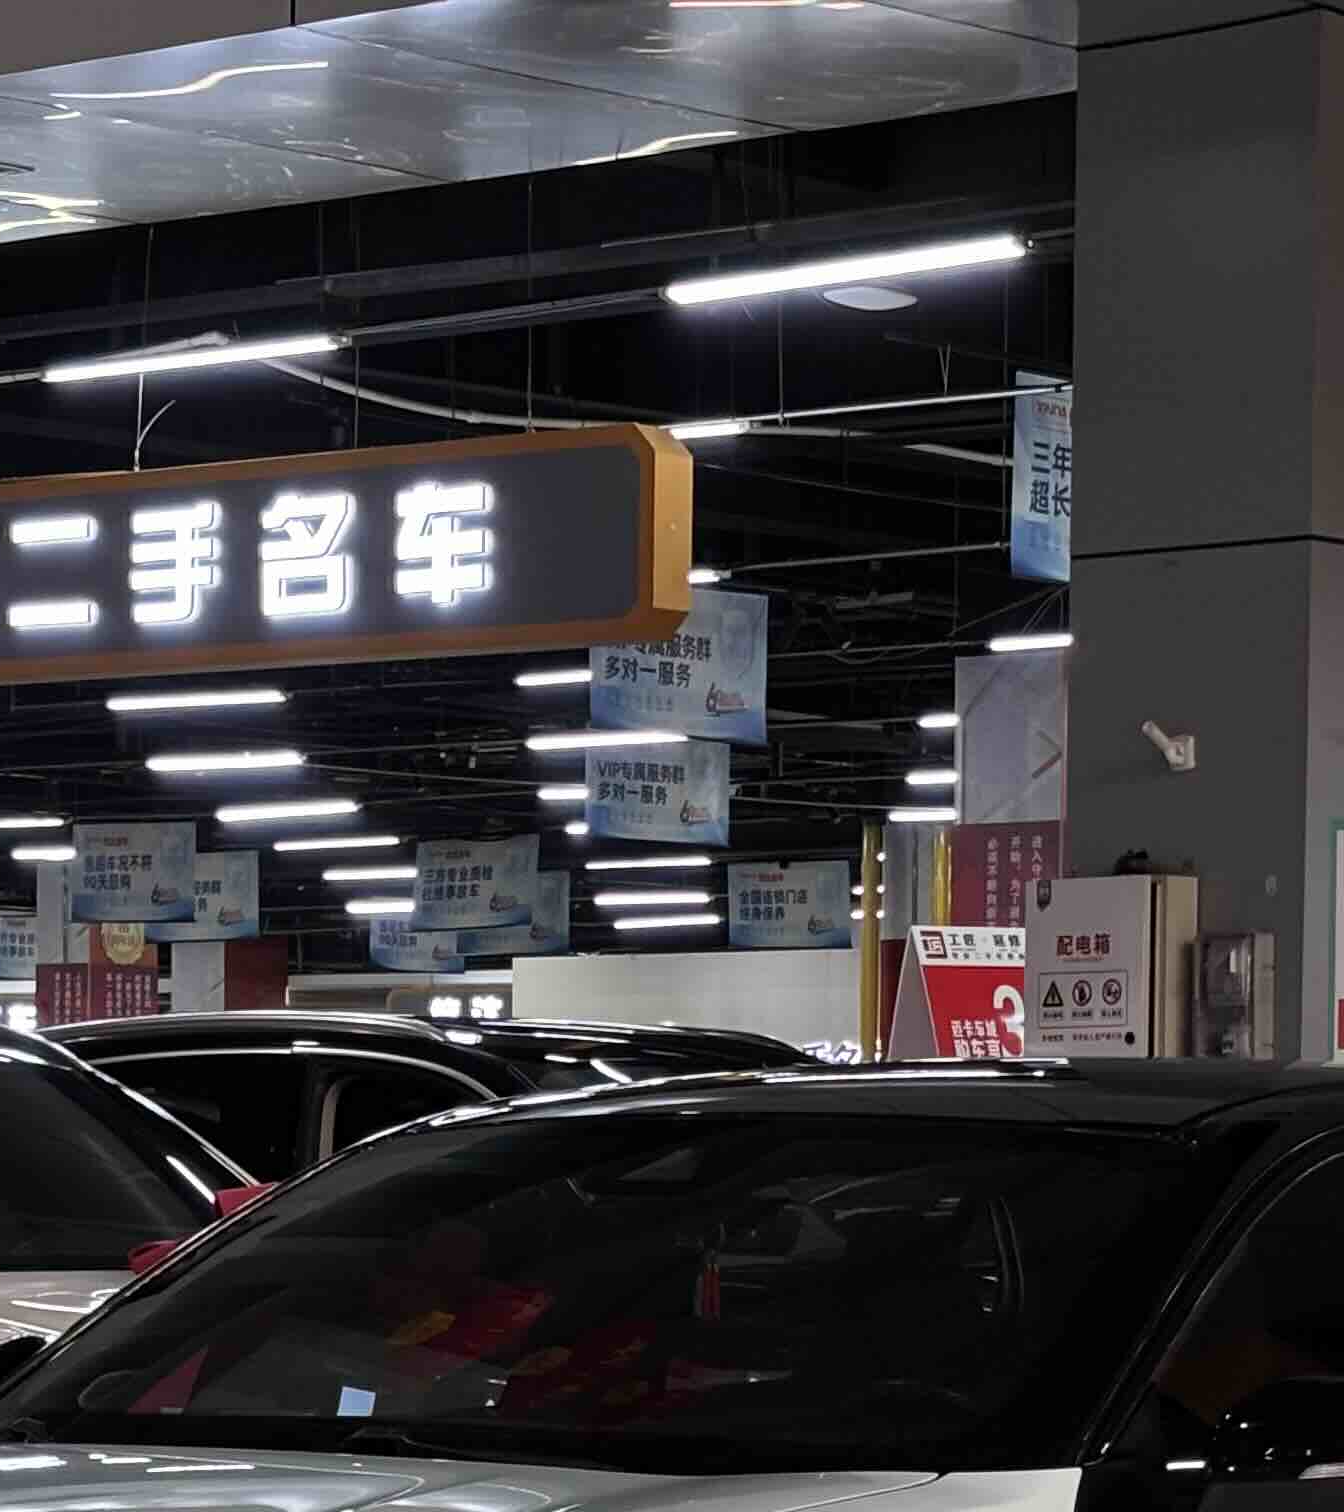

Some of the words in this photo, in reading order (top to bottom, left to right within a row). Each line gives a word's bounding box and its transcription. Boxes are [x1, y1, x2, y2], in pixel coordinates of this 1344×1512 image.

[606, 656, 692, 688] 多对一服务
[1056, 933, 1111, 956] 配电箱
